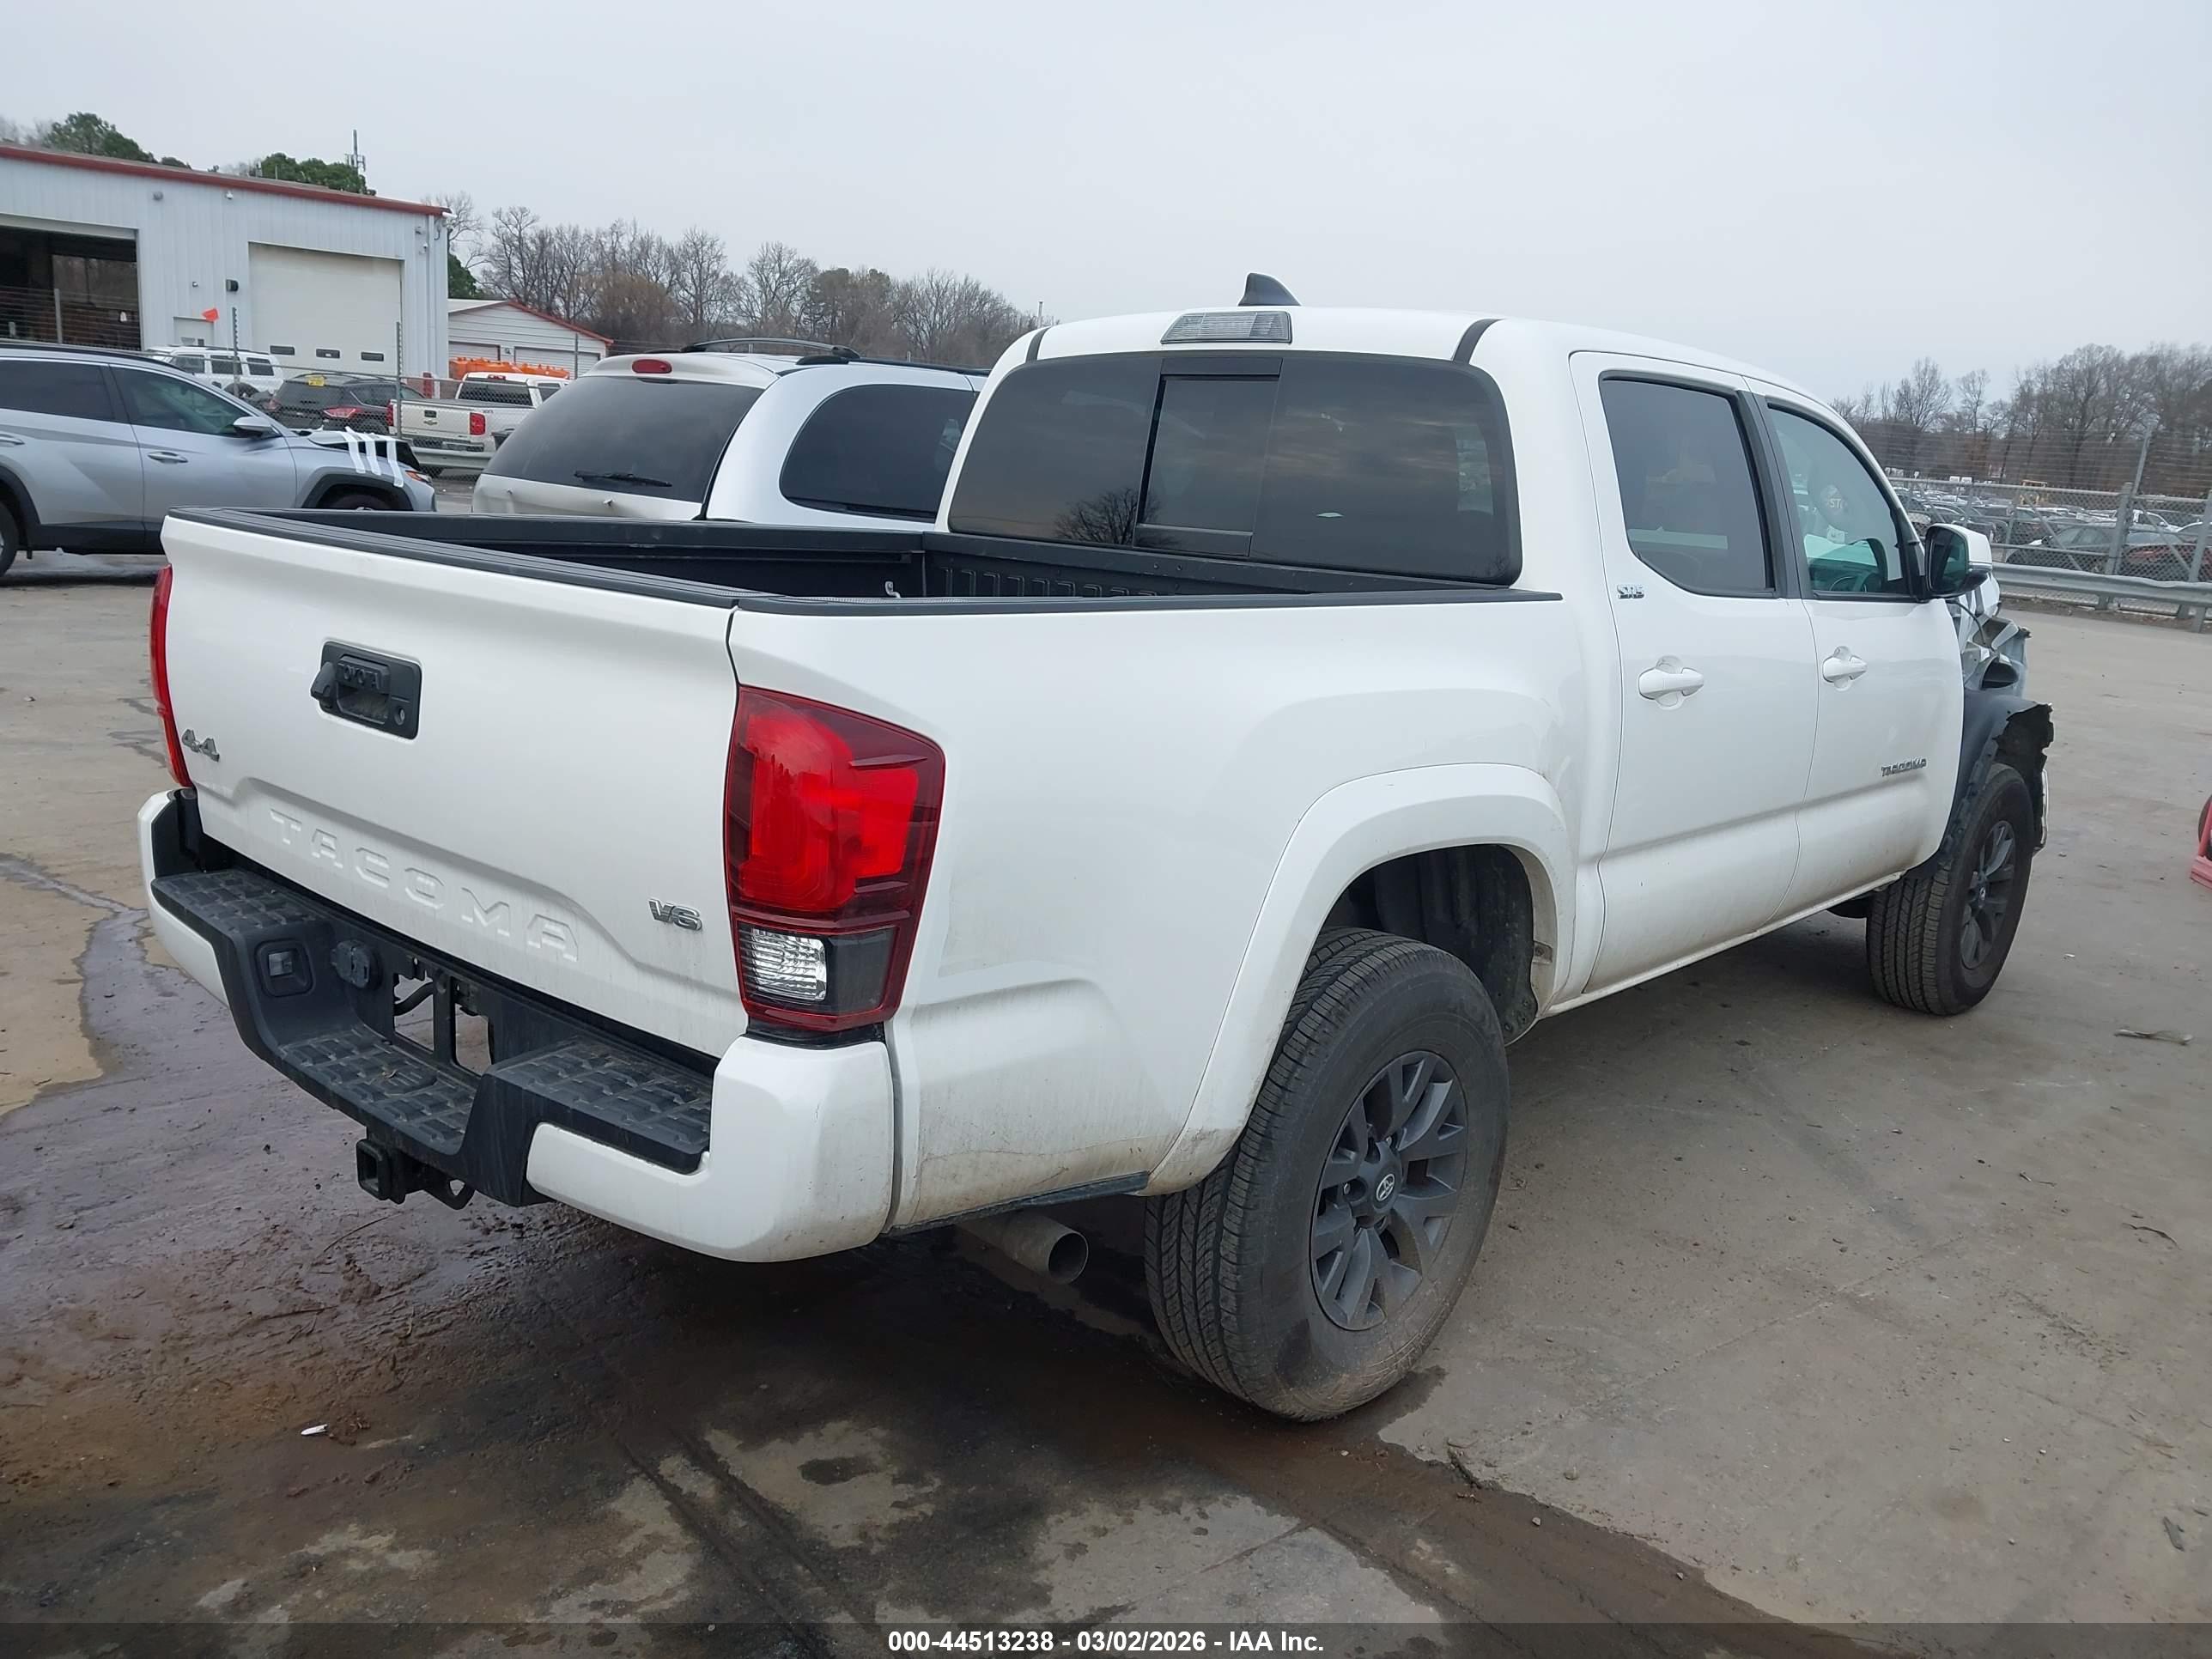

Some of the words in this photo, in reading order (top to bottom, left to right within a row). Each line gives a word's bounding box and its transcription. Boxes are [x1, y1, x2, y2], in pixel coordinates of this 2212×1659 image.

[337, 662, 380, 690] TOYOTA
[270, 808, 579, 963] TACOMA
[648, 898, 702, 932] V6
